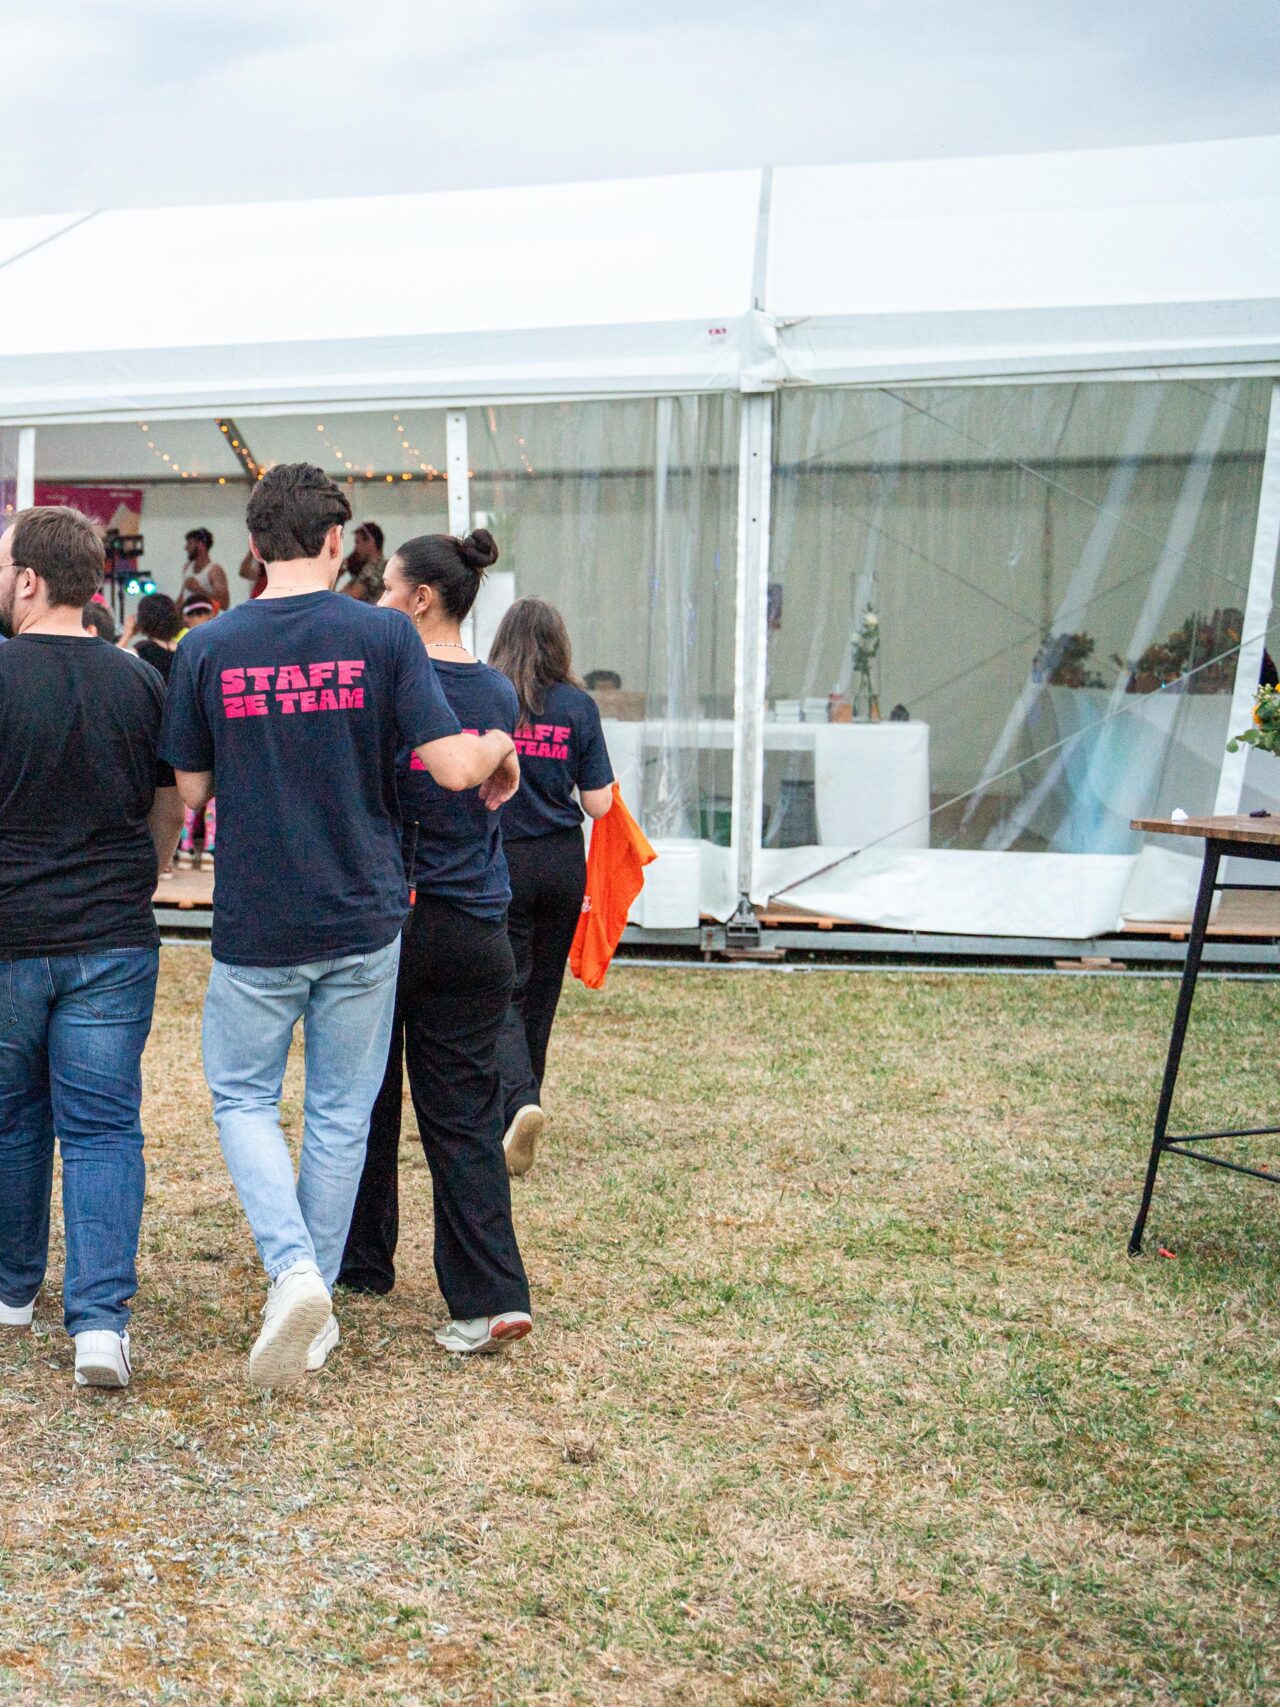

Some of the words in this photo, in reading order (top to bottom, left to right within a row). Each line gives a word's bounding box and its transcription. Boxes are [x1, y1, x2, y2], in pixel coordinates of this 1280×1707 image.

[220, 660, 365, 695] STAFF
[222, 694, 269, 719] ZE
[275, 687, 365, 714] TEAM
[513, 723, 572, 743] AFF
